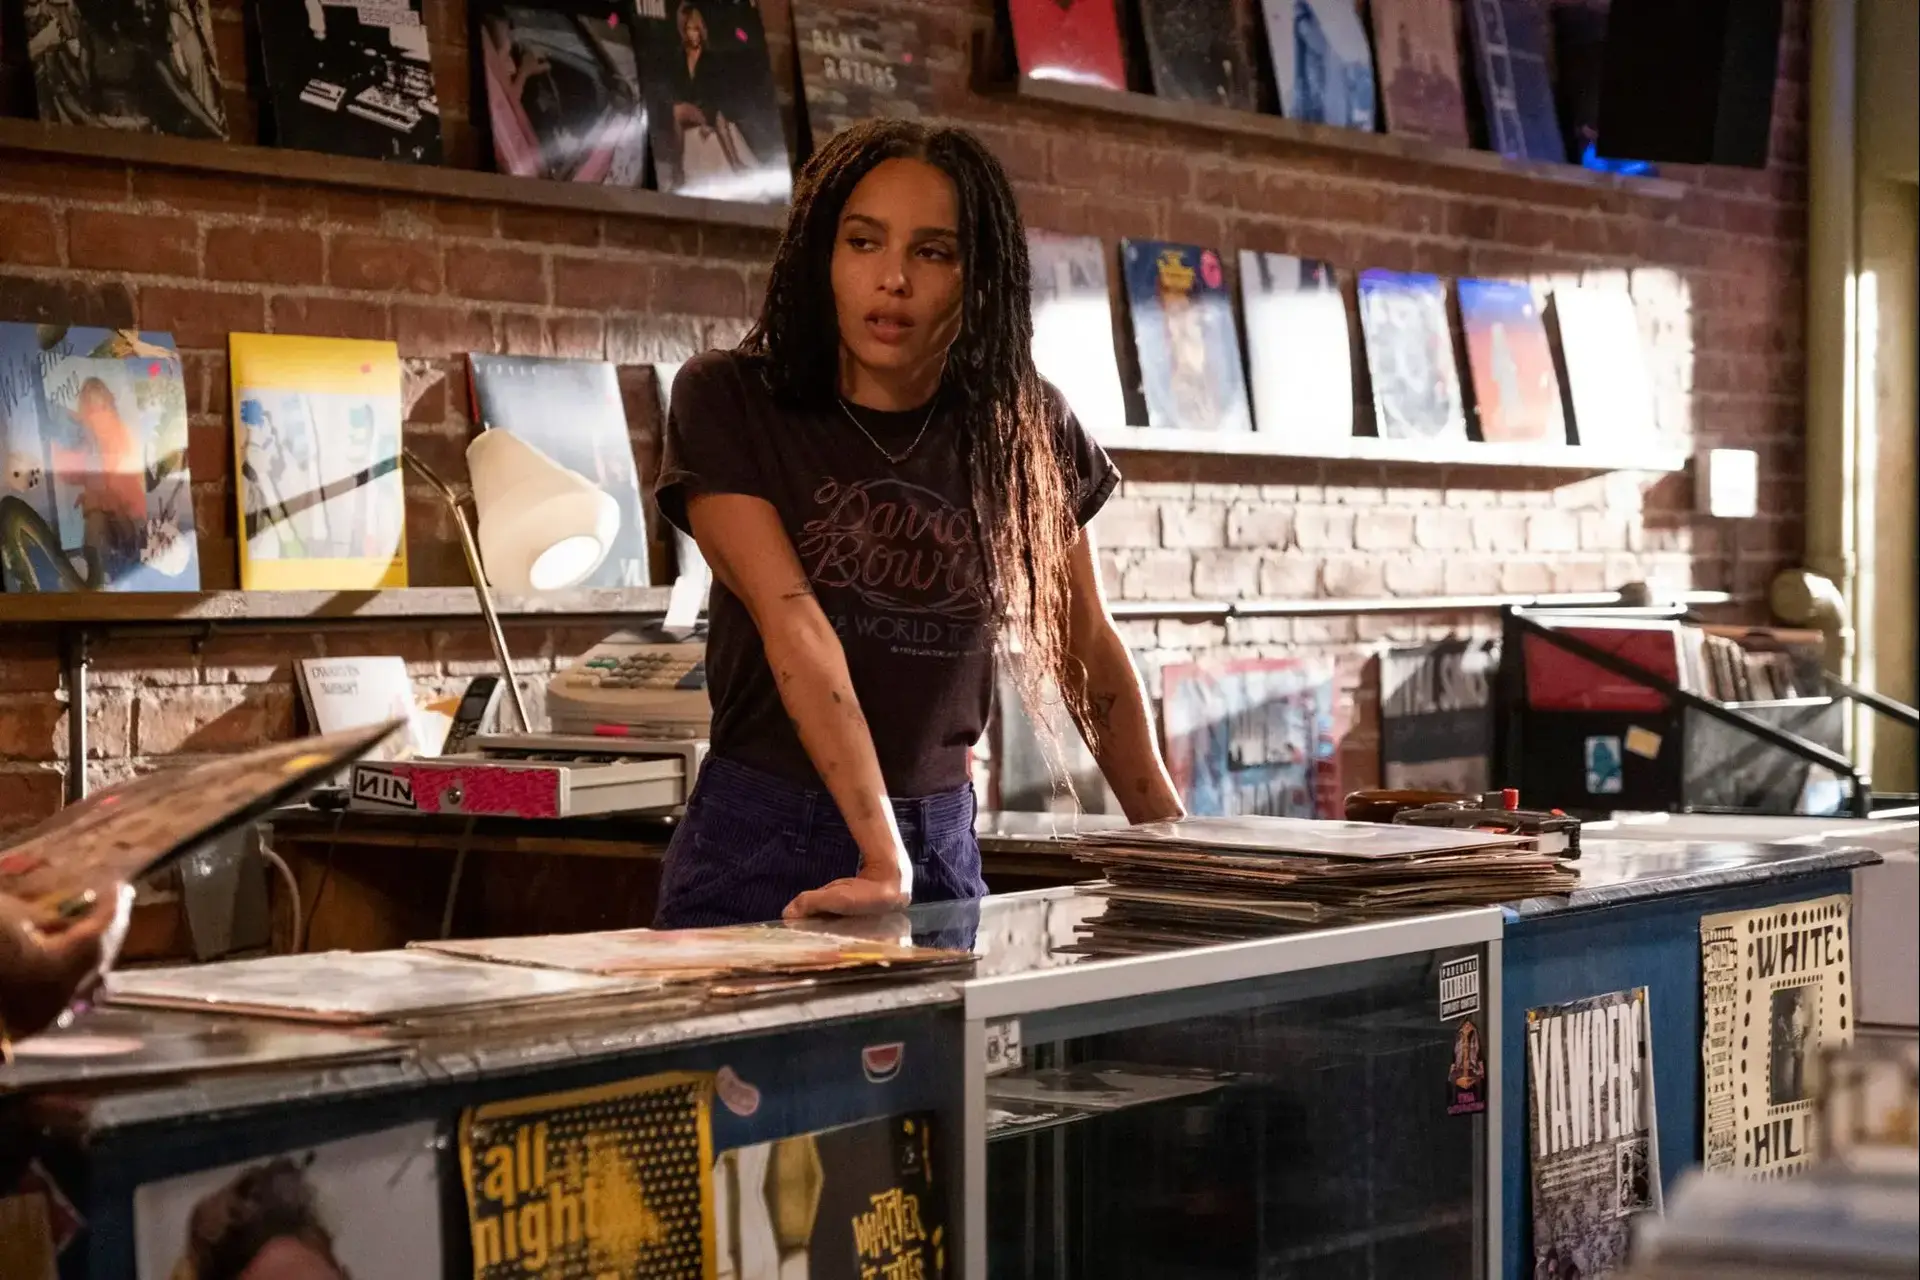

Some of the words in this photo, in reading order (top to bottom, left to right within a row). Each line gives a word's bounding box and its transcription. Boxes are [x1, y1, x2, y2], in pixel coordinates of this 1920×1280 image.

[0, 343, 75, 416] Welome
[854, 615, 942, 643] WORLD
[1442, 960, 1477, 979] PARENTAL
[1756, 925, 1834, 979] WHITE
[483, 1120, 546, 1207] all
[1753, 1114, 1816, 1168] HIL
[473, 1177, 599, 1272] night
